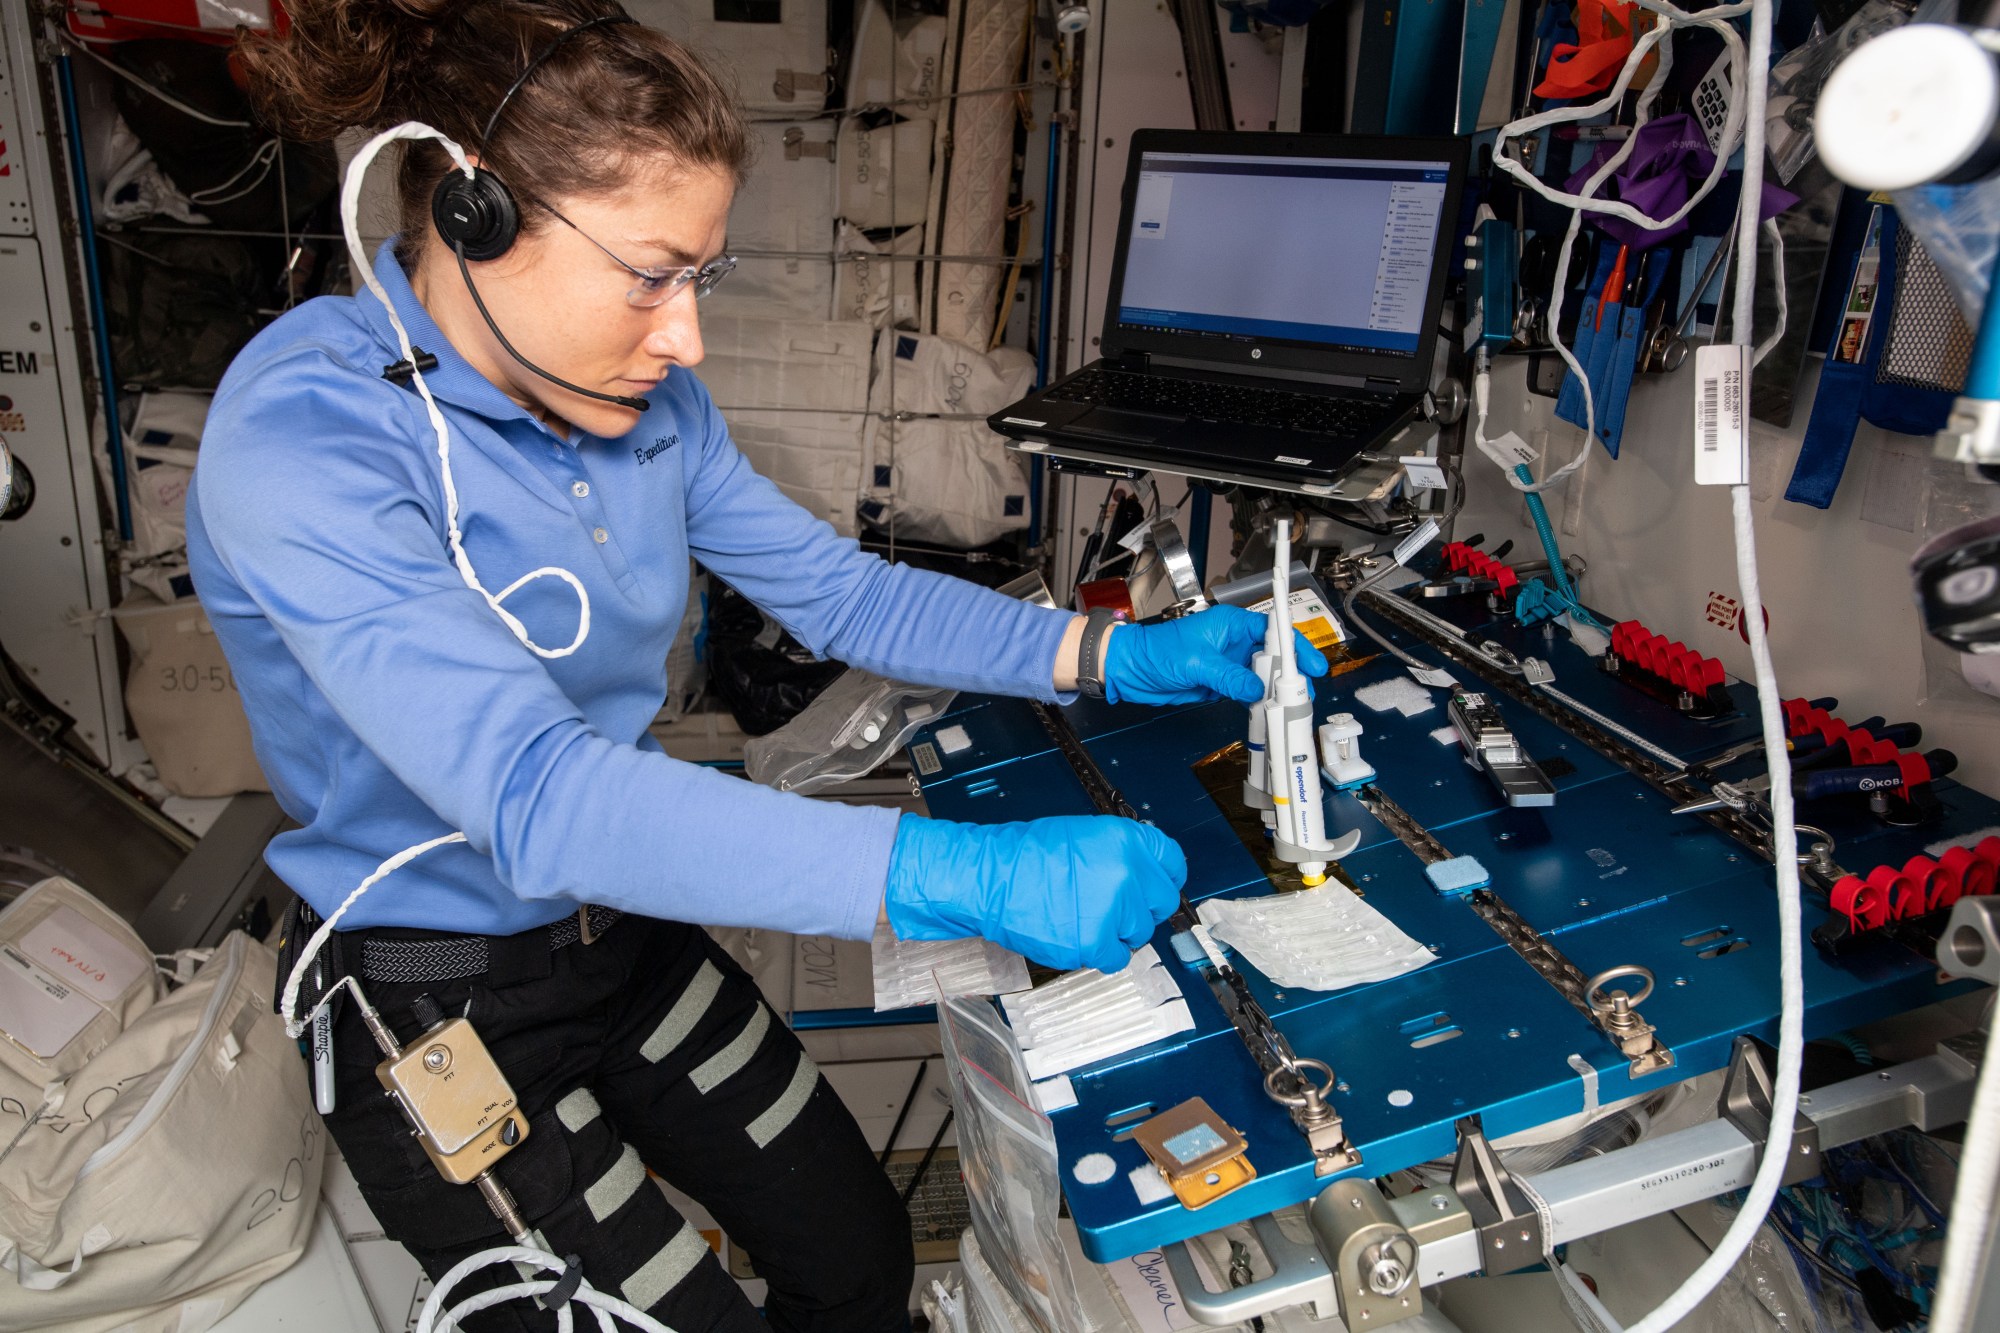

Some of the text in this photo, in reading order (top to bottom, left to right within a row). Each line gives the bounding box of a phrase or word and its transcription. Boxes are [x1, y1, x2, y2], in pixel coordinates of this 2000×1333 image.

[1724, 370, 1732, 384] S/N
[1732, 370, 1740, 384] P/N
[634, 434, 679, 466] Expedition
[1249, 601, 1271, 611] Genes
[1721, 605, 1733, 614] PORT
[161, 664, 240, 692] 3.0-5
[1296, 766, 1307, 803] eppendorf
[315, 1012, 330, 1065] Sharpie
[443, 1071, 455, 1082] PTT
[484, 1098, 513, 1113] DUAL VOX
[477, 1115, 488, 1127] PTT
[482, 1140, 497, 1154] MODE
[1131, 1251, 1177, 1332] Cleaner
